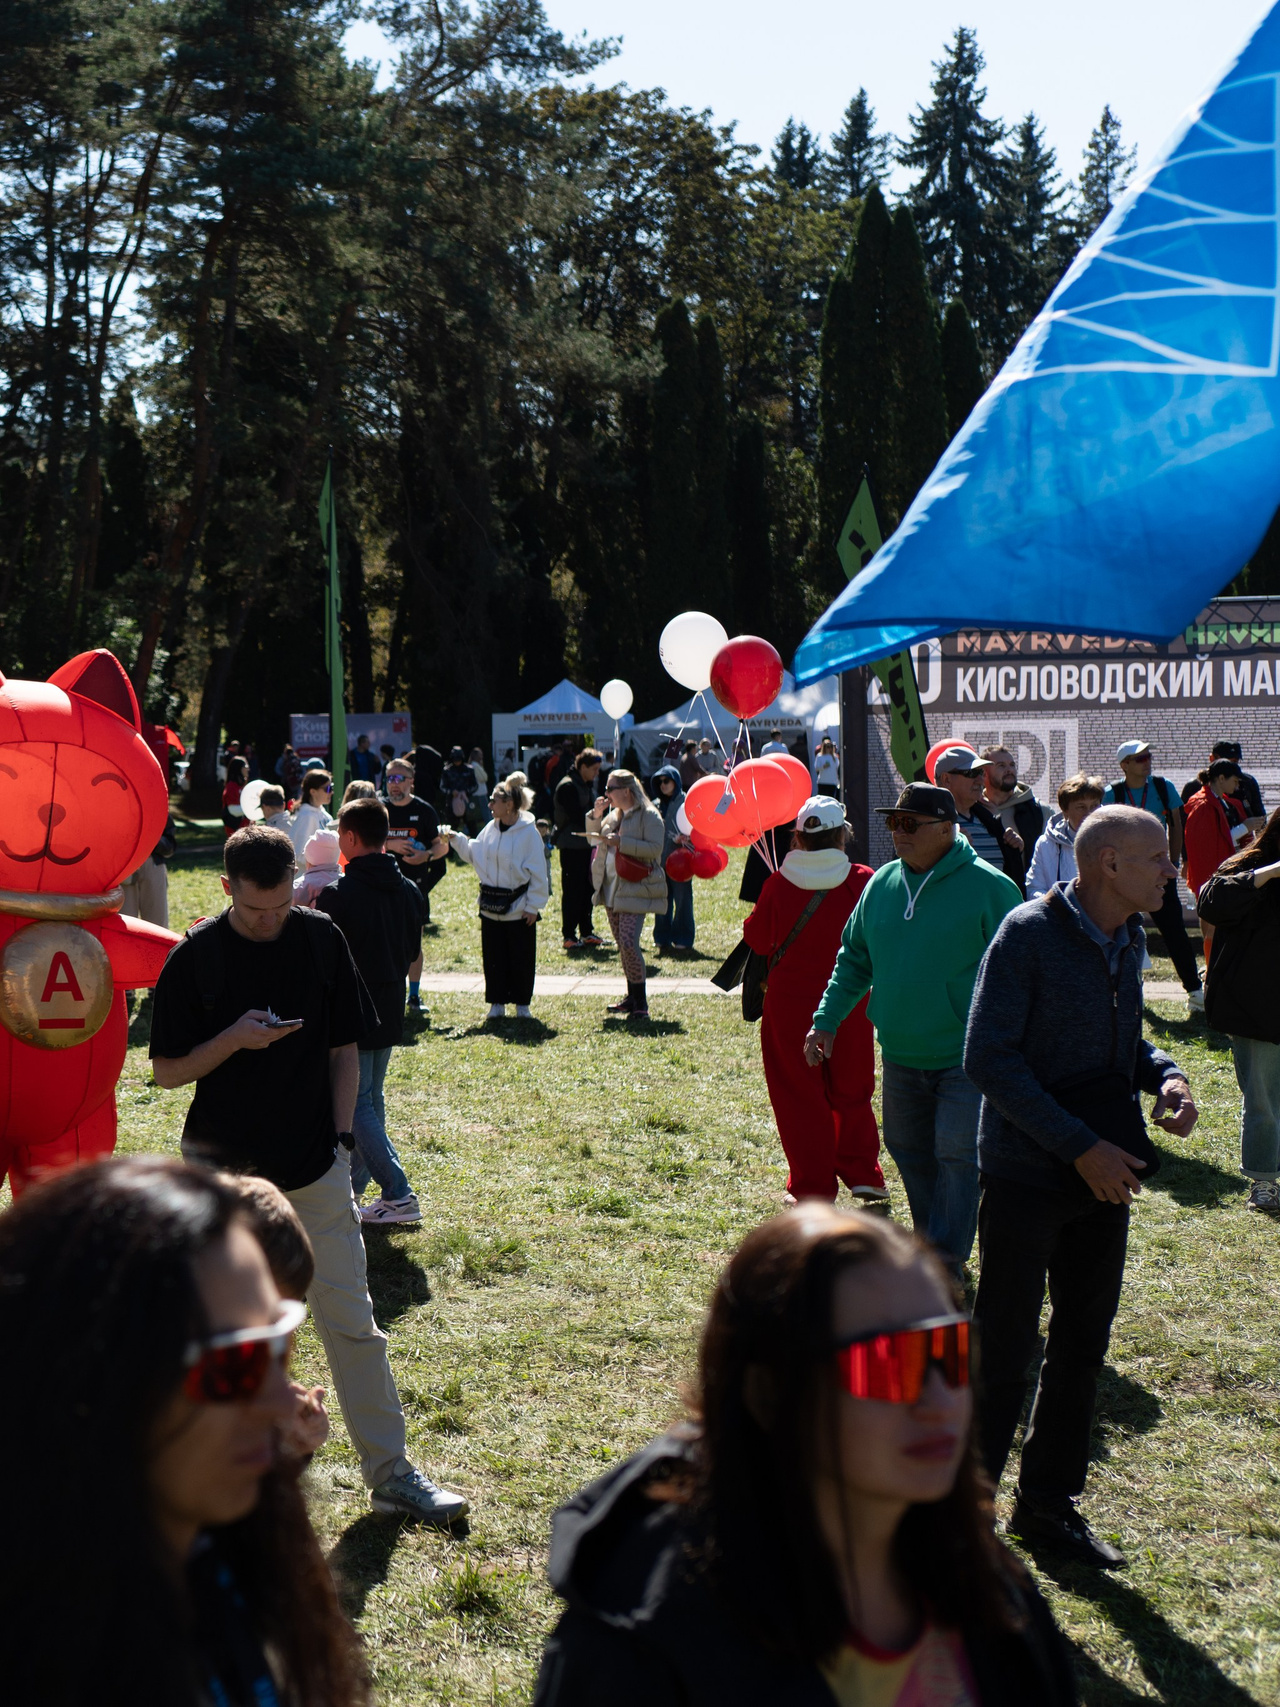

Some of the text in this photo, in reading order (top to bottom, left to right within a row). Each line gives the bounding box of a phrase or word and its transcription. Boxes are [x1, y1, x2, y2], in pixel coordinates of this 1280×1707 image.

[957, 654, 1213, 703] КИСЛОВОДСКИЙ
[523, 713, 587, 722] MAYRVEDA
[746, 719, 802, 727] AYRVEDA
[39, 951, 85, 1003] А
